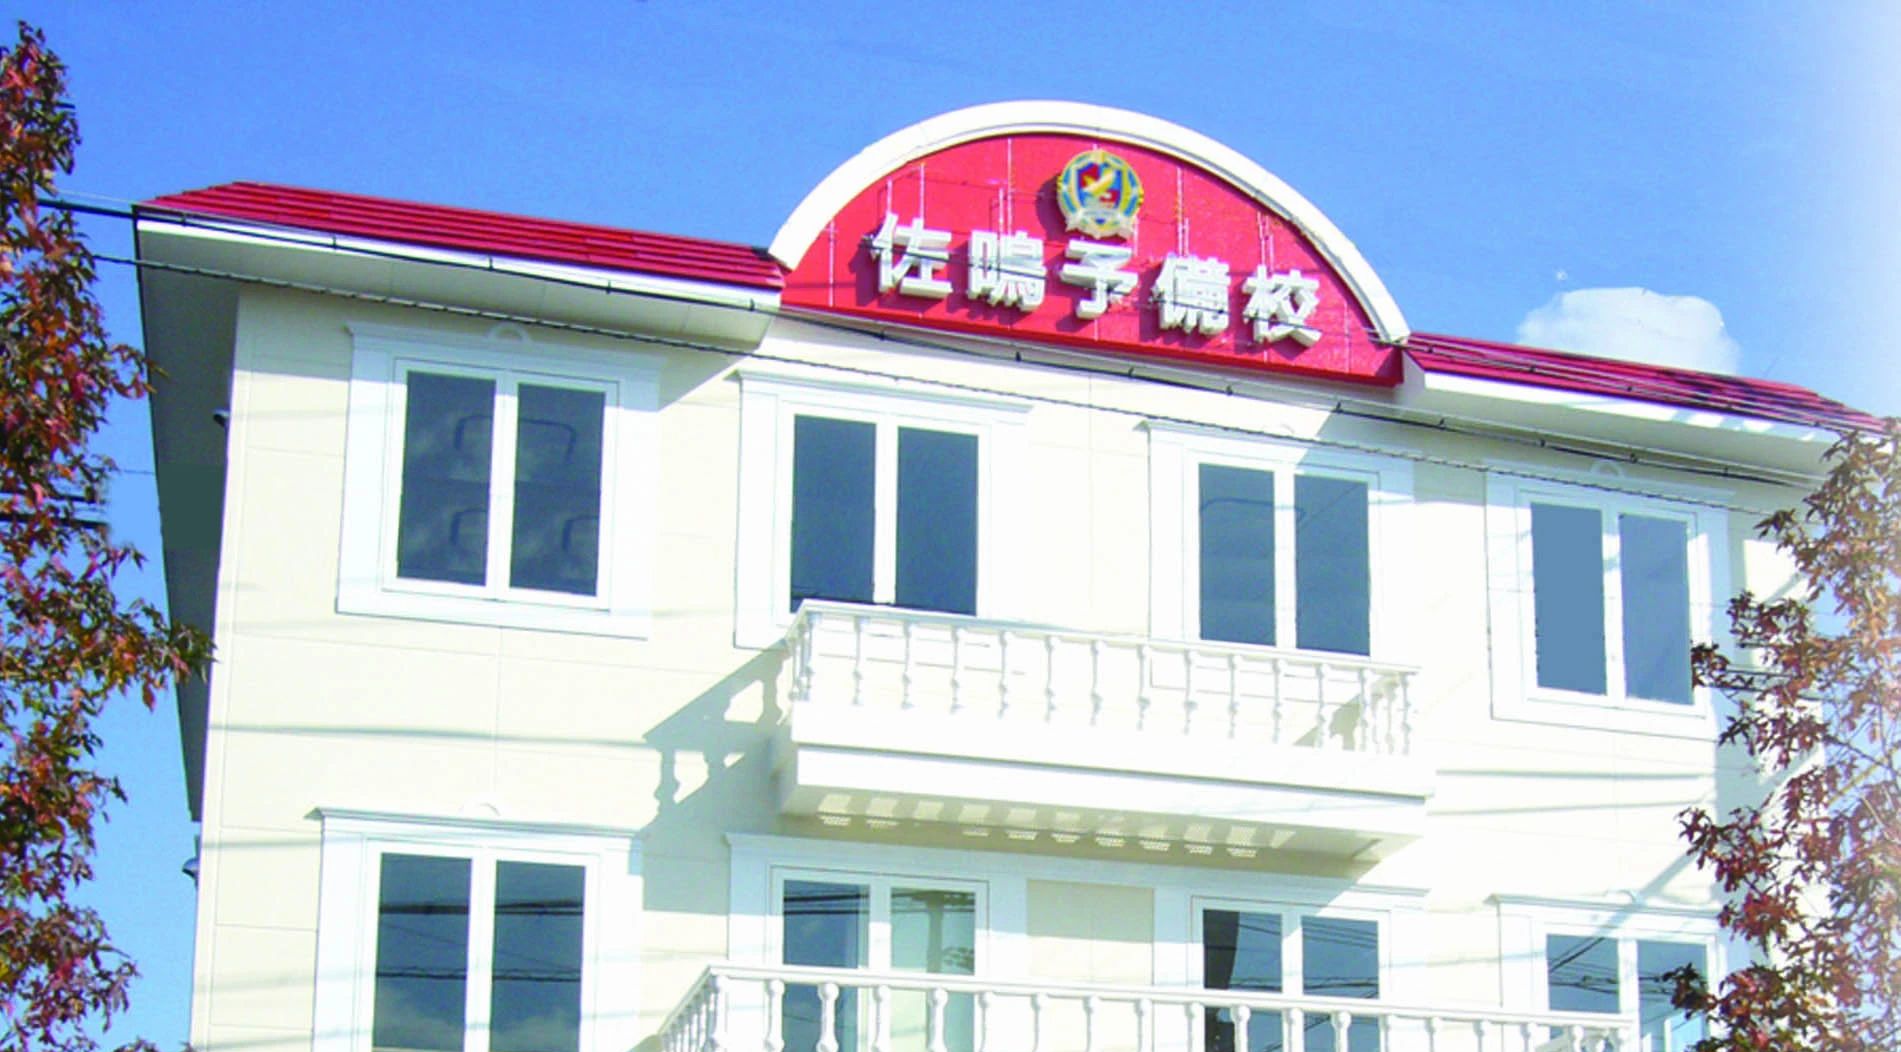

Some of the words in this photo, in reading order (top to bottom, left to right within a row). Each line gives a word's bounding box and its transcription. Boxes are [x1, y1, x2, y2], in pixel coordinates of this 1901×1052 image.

[870, 212, 1322, 347] 佐鳴予備校
